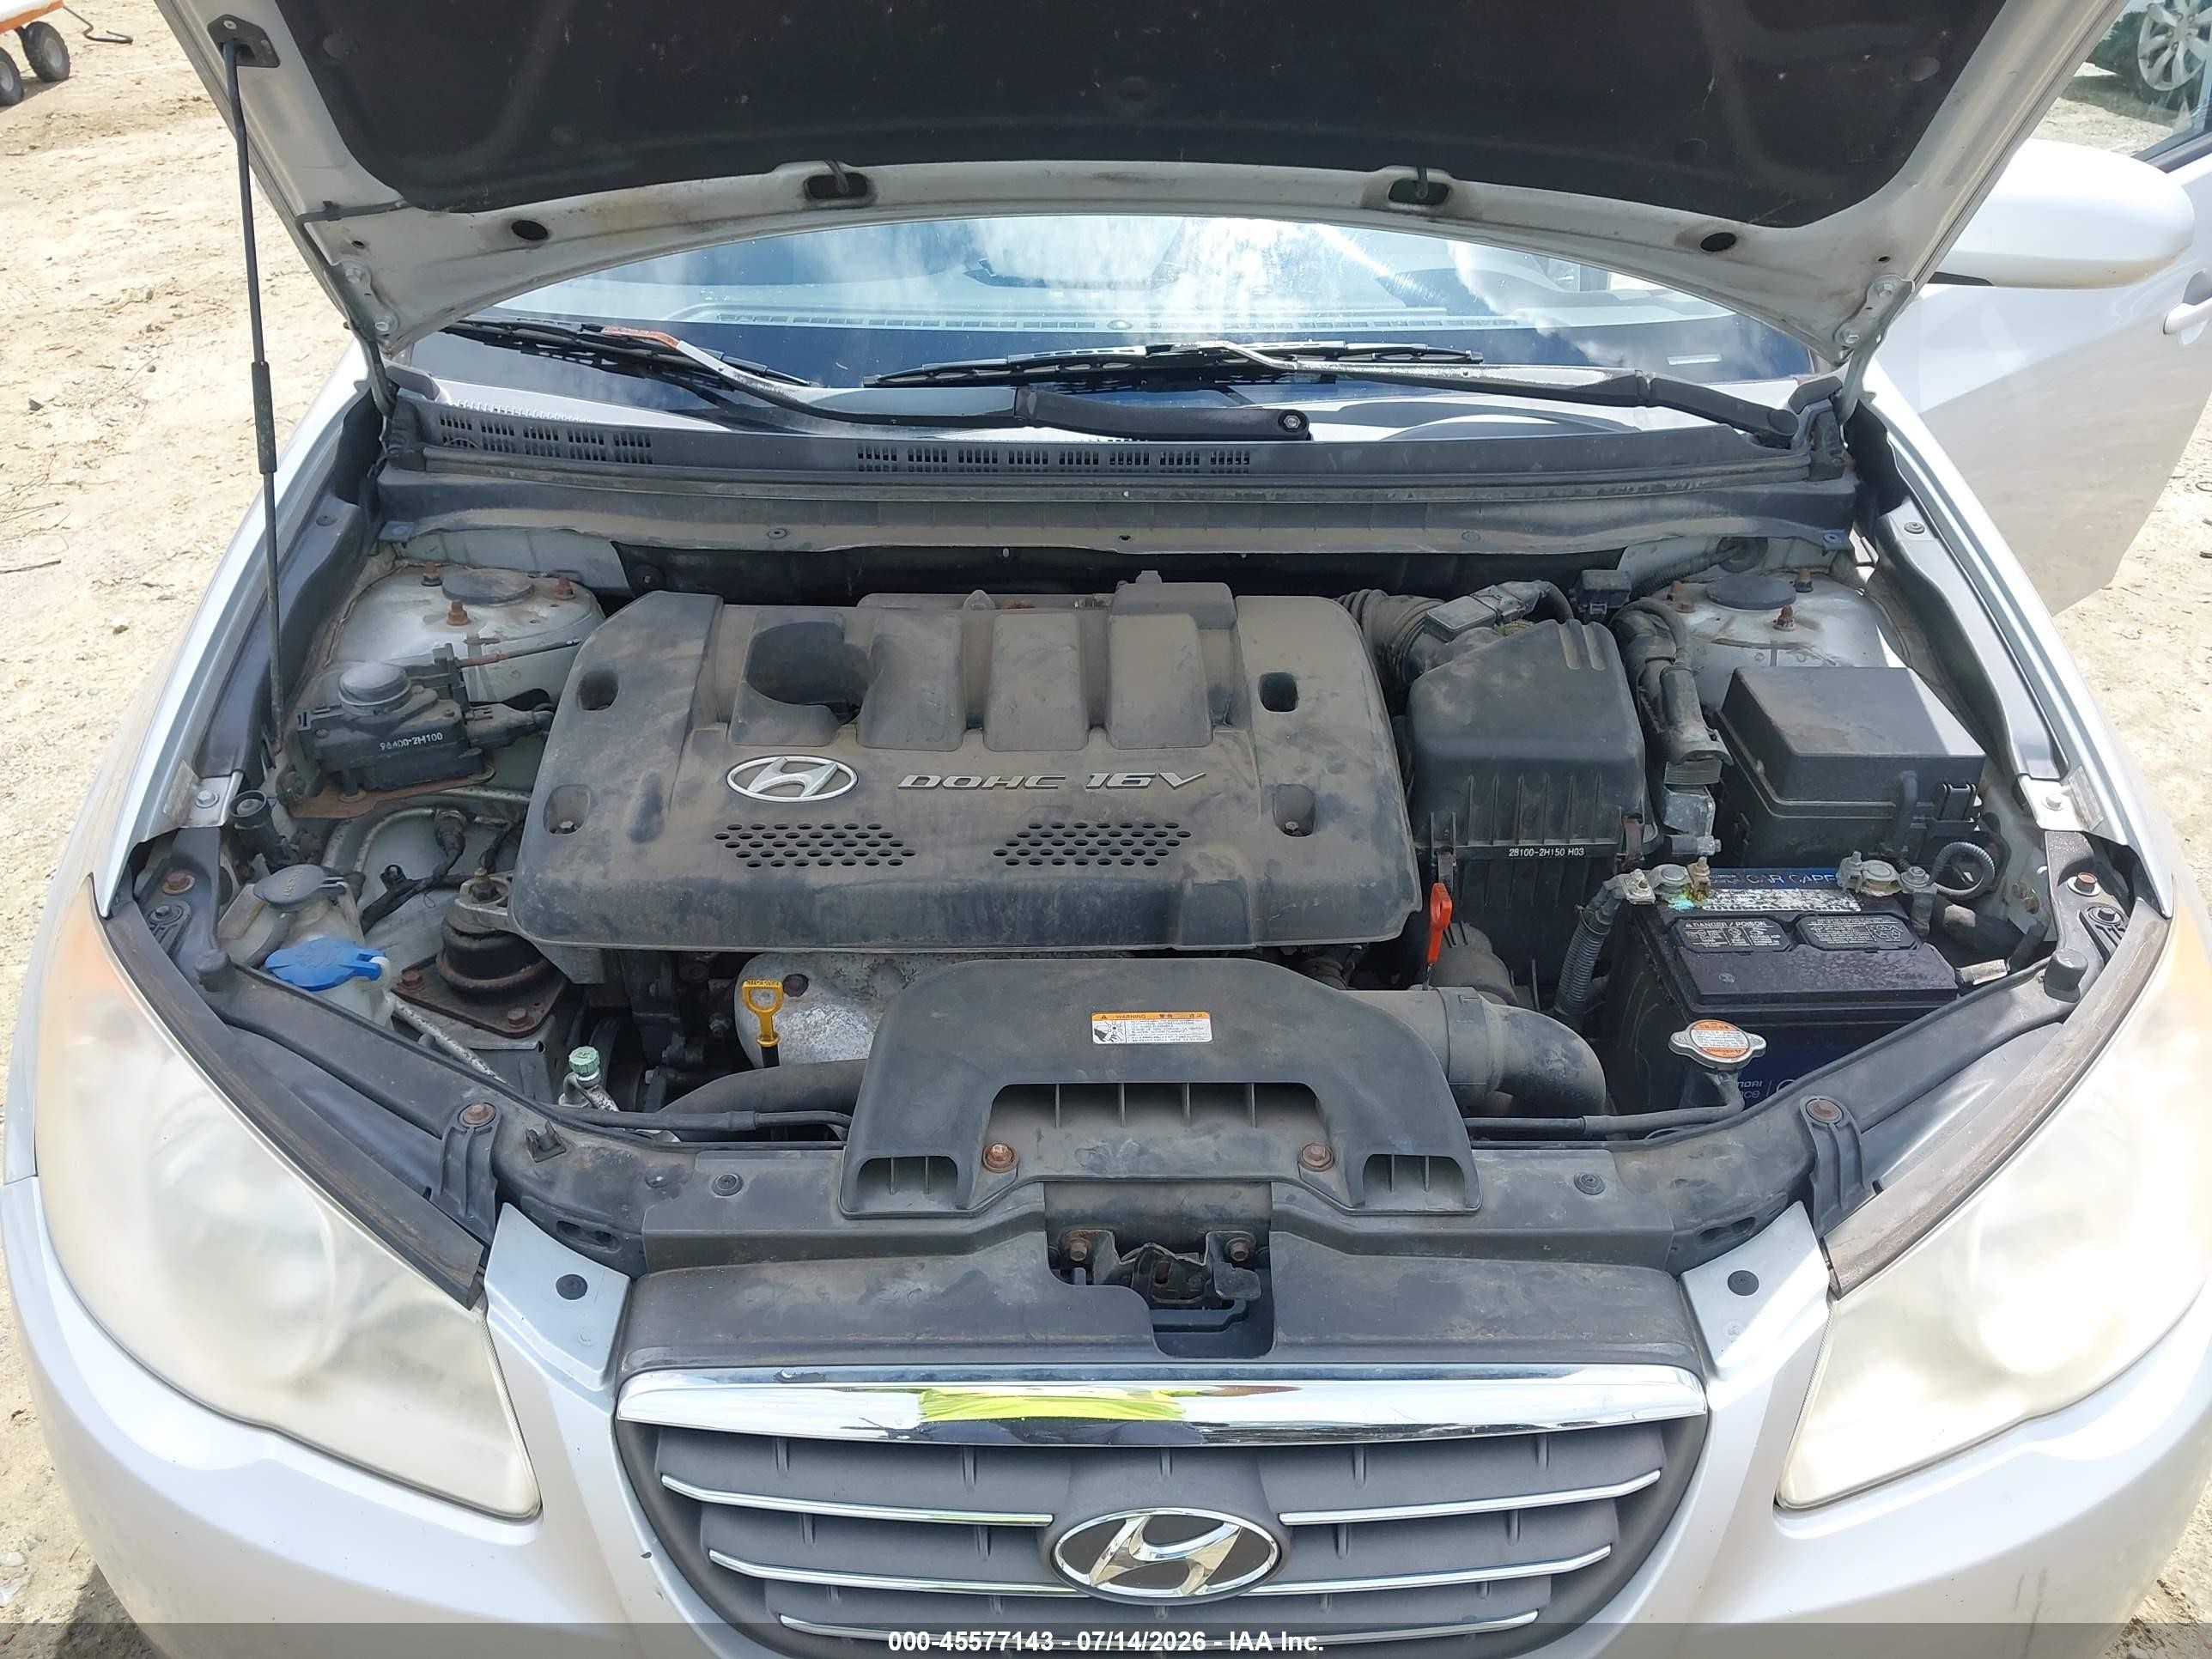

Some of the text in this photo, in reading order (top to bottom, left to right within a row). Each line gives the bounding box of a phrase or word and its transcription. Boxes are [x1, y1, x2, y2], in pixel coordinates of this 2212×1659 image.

[897, 773, 1207, 789] DOHC 16V
[1509, 848, 1584, 857] 28100-2H150 H03
